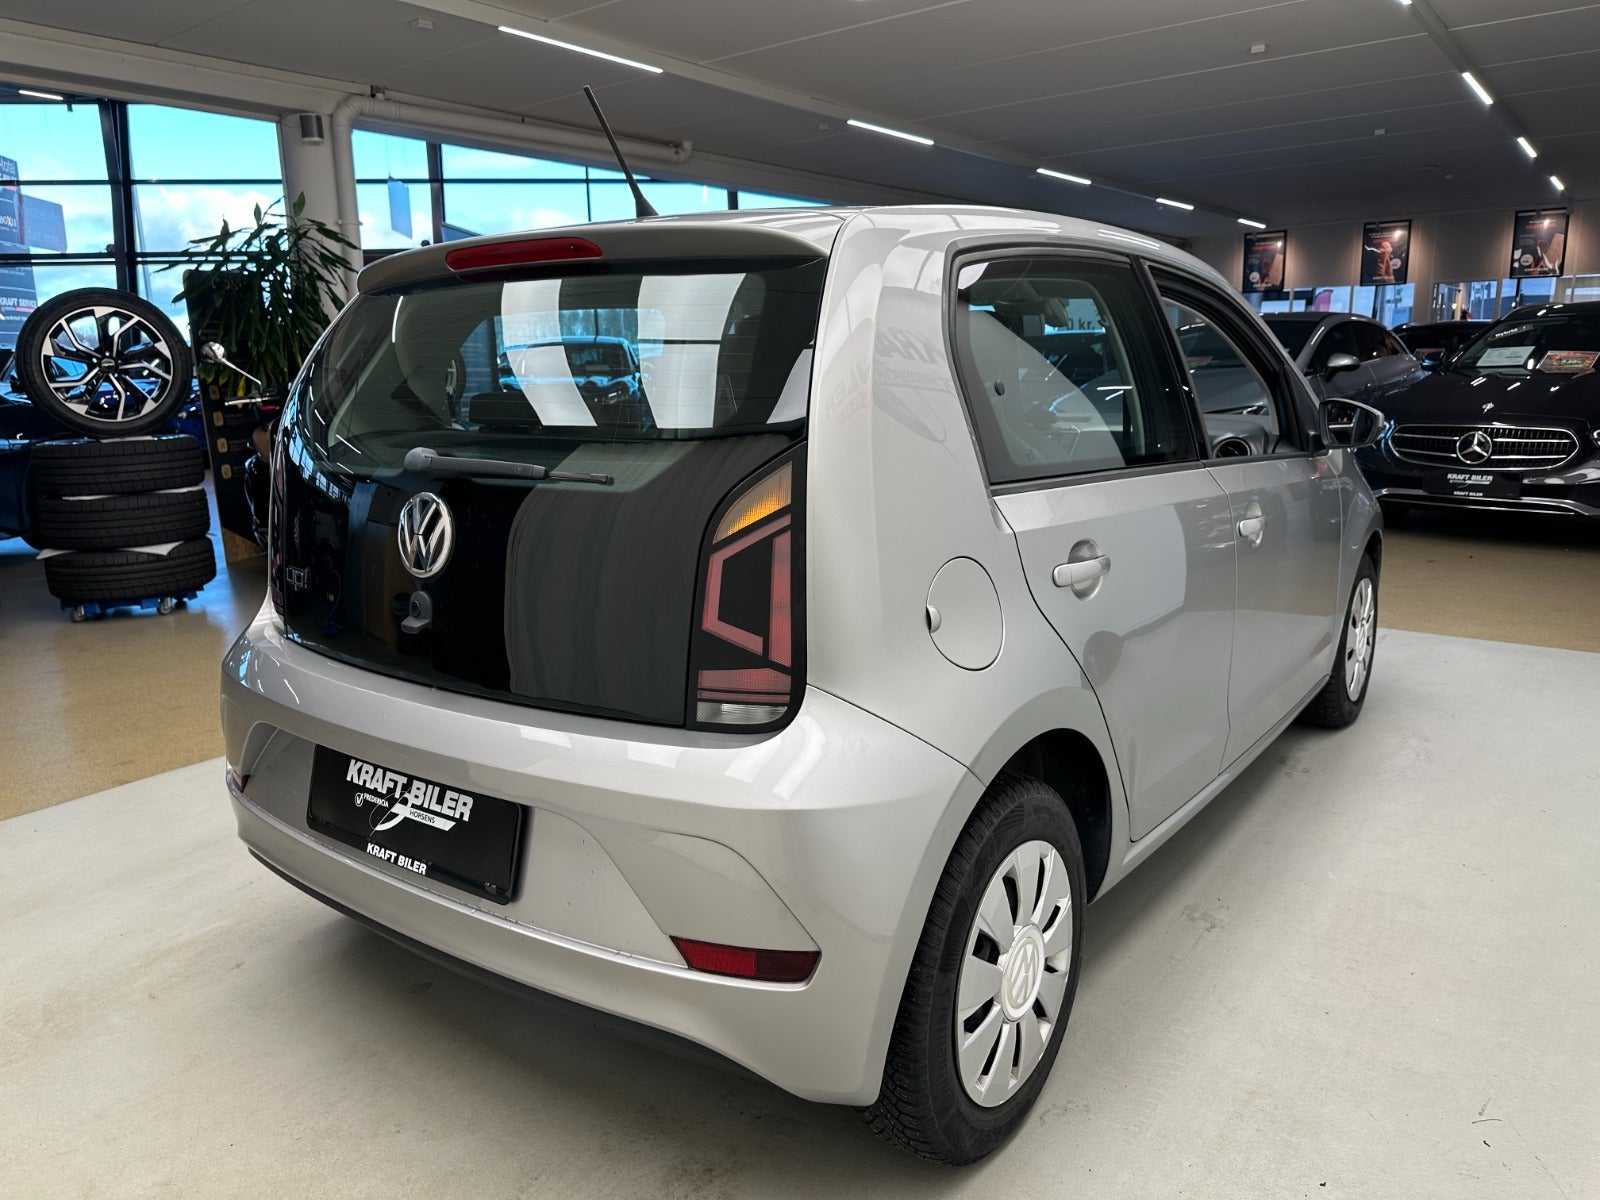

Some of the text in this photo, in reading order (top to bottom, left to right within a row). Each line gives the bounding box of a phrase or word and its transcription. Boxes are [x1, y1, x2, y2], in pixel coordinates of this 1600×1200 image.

[1079, 317, 1095, 330] kr.
[346, 759, 473, 821] KRAFT BILER
[409, 809, 435, 825] HORSENS
[366, 842, 427, 876] KRAFT BILER
